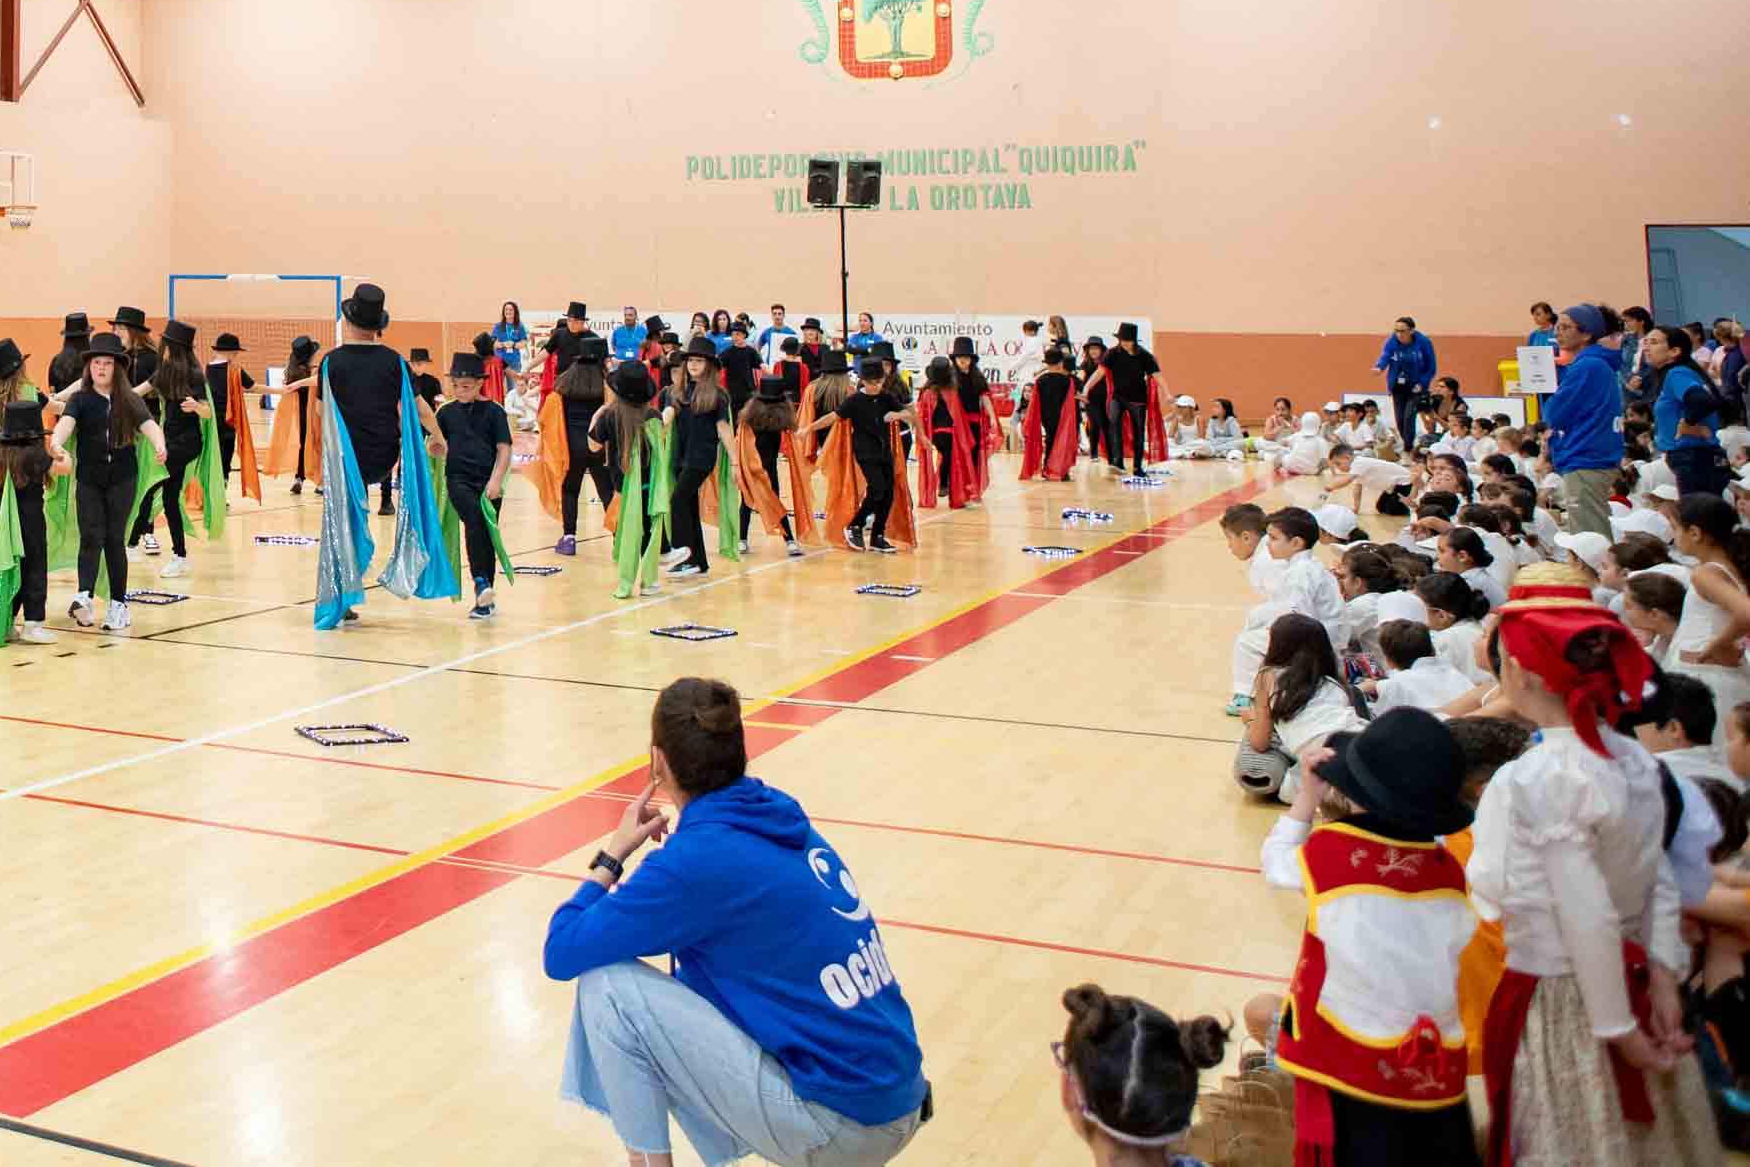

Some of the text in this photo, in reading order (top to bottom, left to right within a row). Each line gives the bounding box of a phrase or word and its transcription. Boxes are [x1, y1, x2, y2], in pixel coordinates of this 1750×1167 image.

[878, 146, 1007, 176] MUNICIPAL
[889, 186, 919, 211] LA
[930, 182, 1033, 211] OROTAVA
[883, 321, 993, 337] Ayuntamiento
